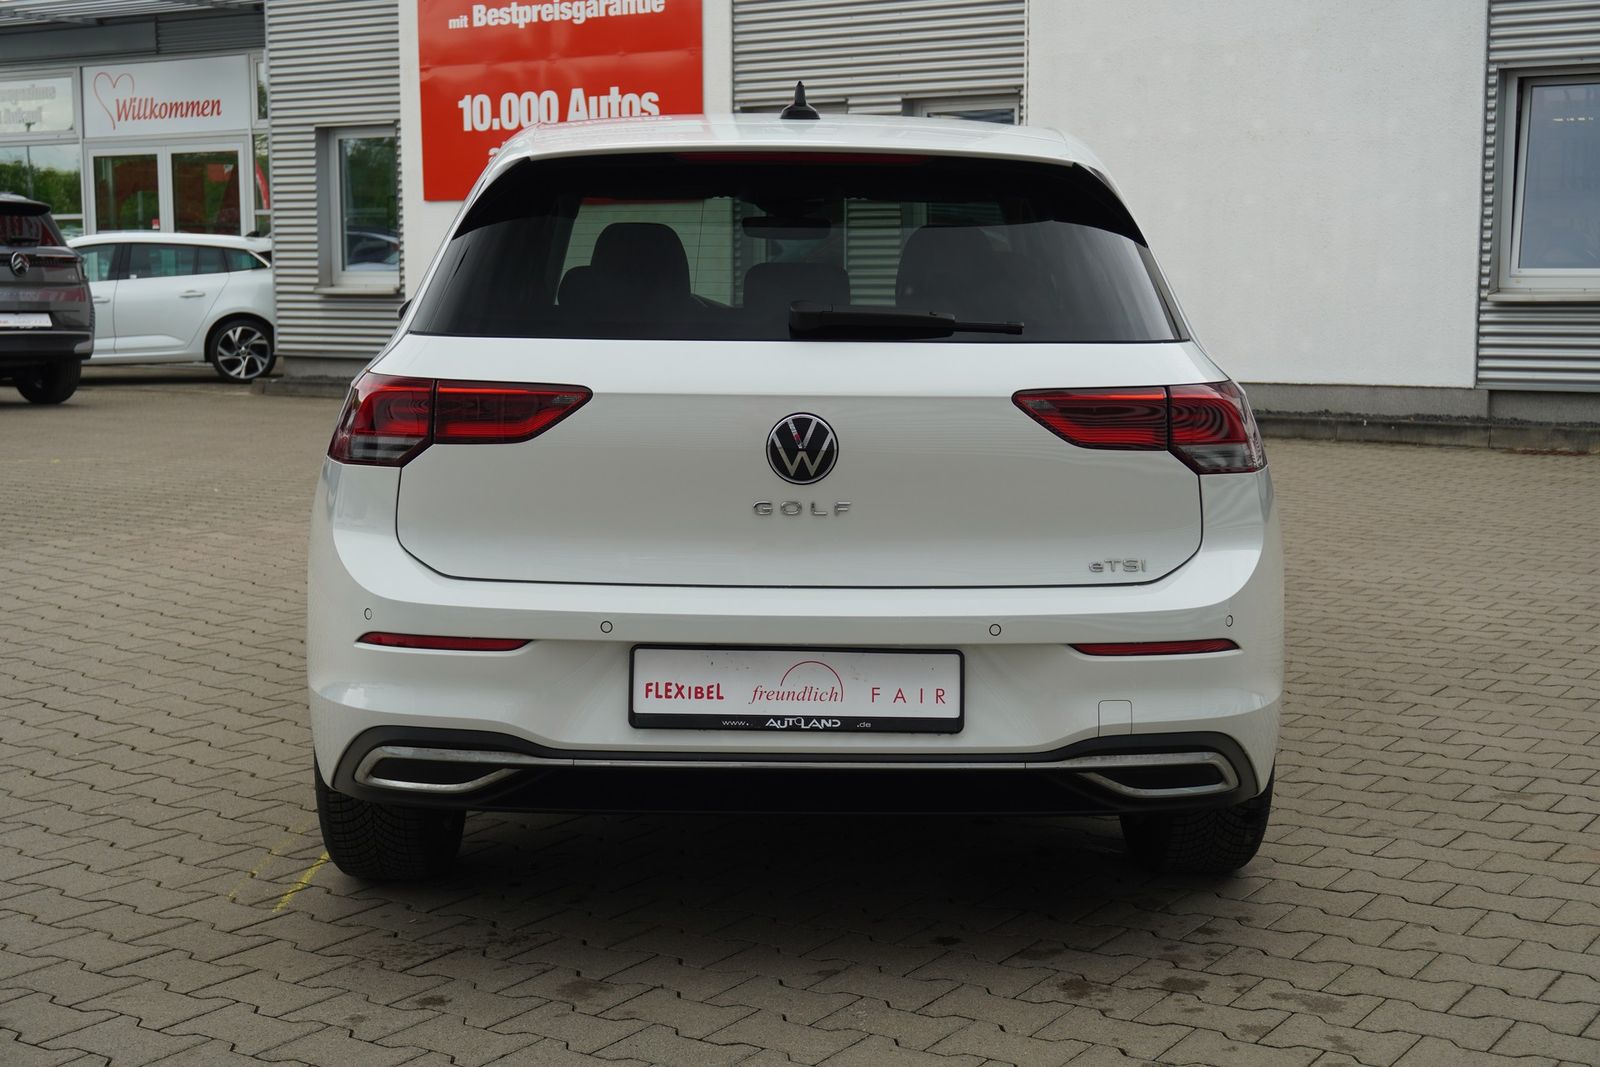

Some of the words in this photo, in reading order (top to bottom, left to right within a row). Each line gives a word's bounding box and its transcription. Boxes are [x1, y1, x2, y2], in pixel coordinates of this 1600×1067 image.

[448, 15, 469, 29] mit
[472, 0, 666, 29] Bestpreisgarantie
[115, 98, 223, 122] Willkommen
[457, 90, 560, 132] 10.000
[567, 86, 661, 123] Autos
[752, 501, 852, 516] GOLF
[1088, 559, 1147, 573] eTSI
[645, 682, 724, 700] FLEXIBEL
[748, 685, 839, 705] freundlich
[871, 687, 946, 704] FAIR
